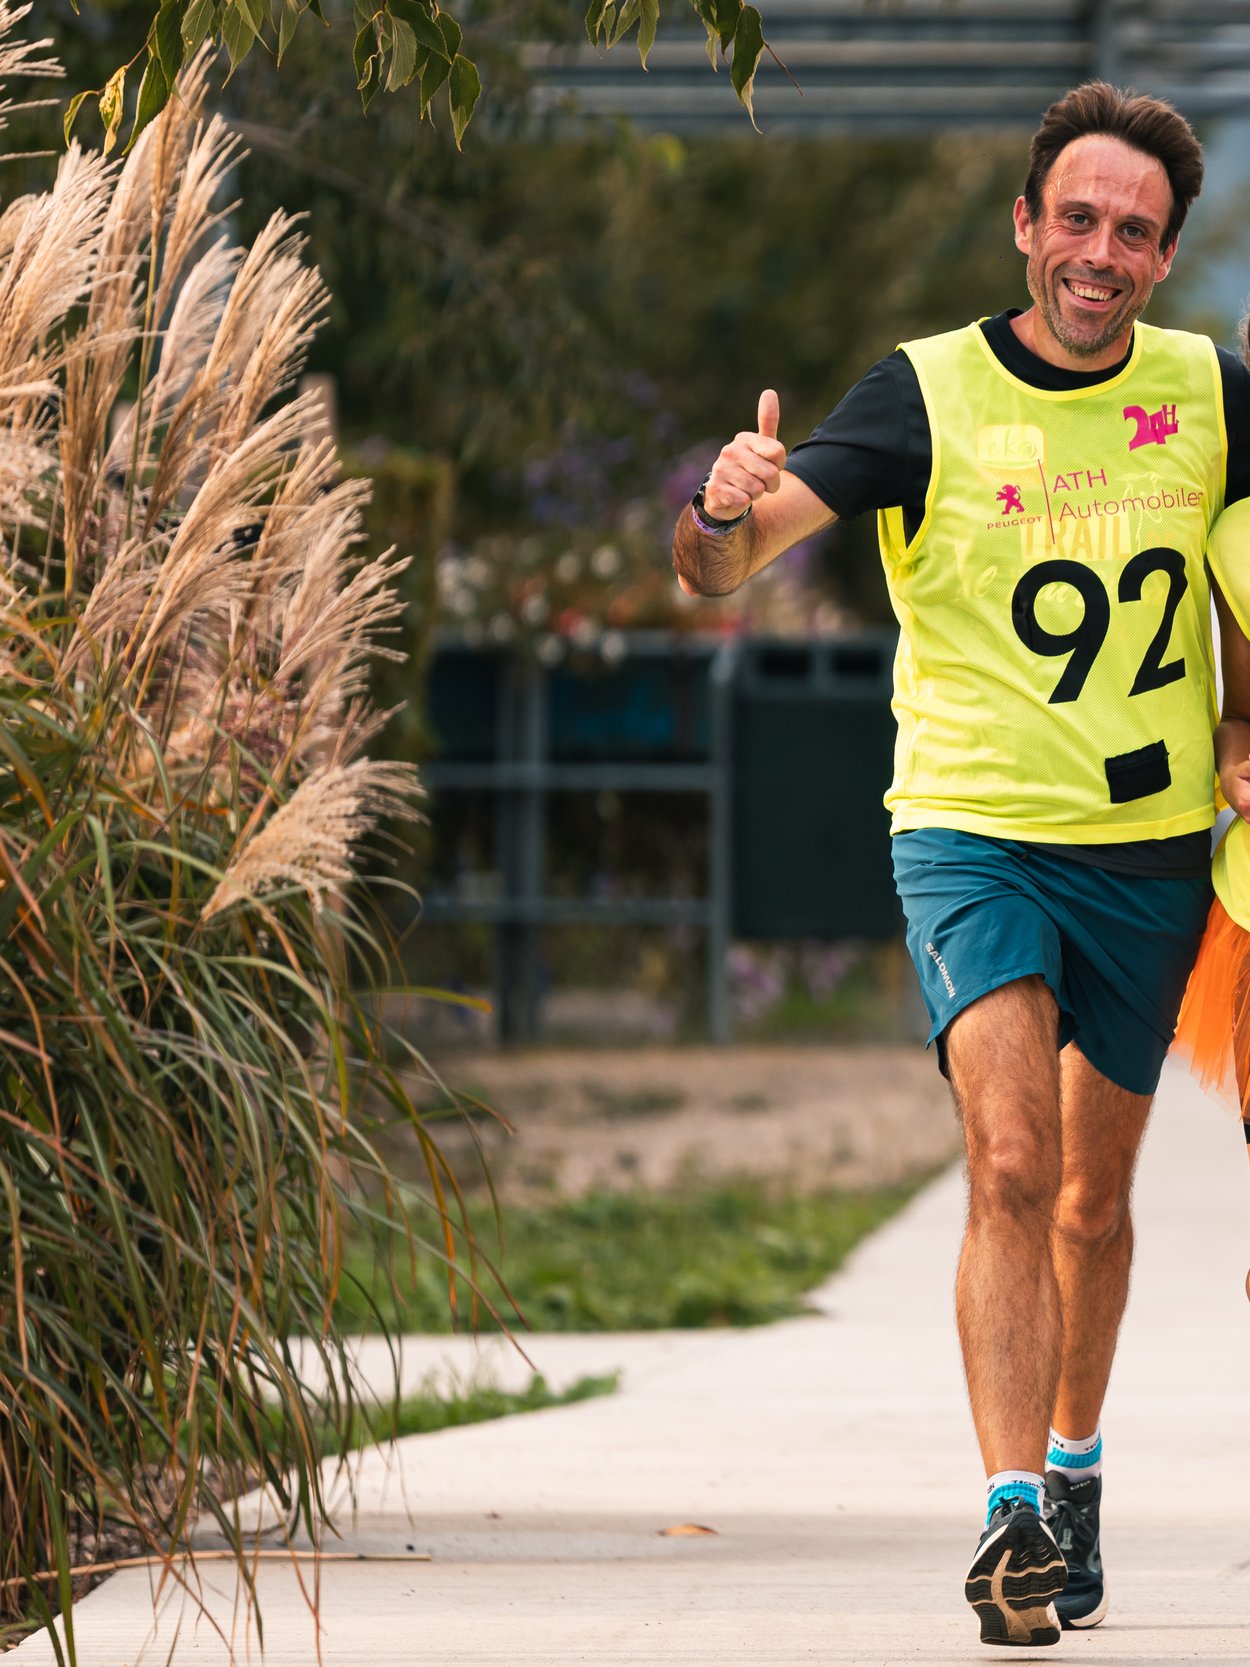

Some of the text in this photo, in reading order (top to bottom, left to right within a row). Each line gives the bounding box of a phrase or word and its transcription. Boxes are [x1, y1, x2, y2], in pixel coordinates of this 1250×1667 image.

[1053, 468, 1107, 493] ATH
[986, 515, 1042, 531] PEUGEOT
[1011, 547, 1189, 704] 92
[925, 942, 956, 999] SALOMON
